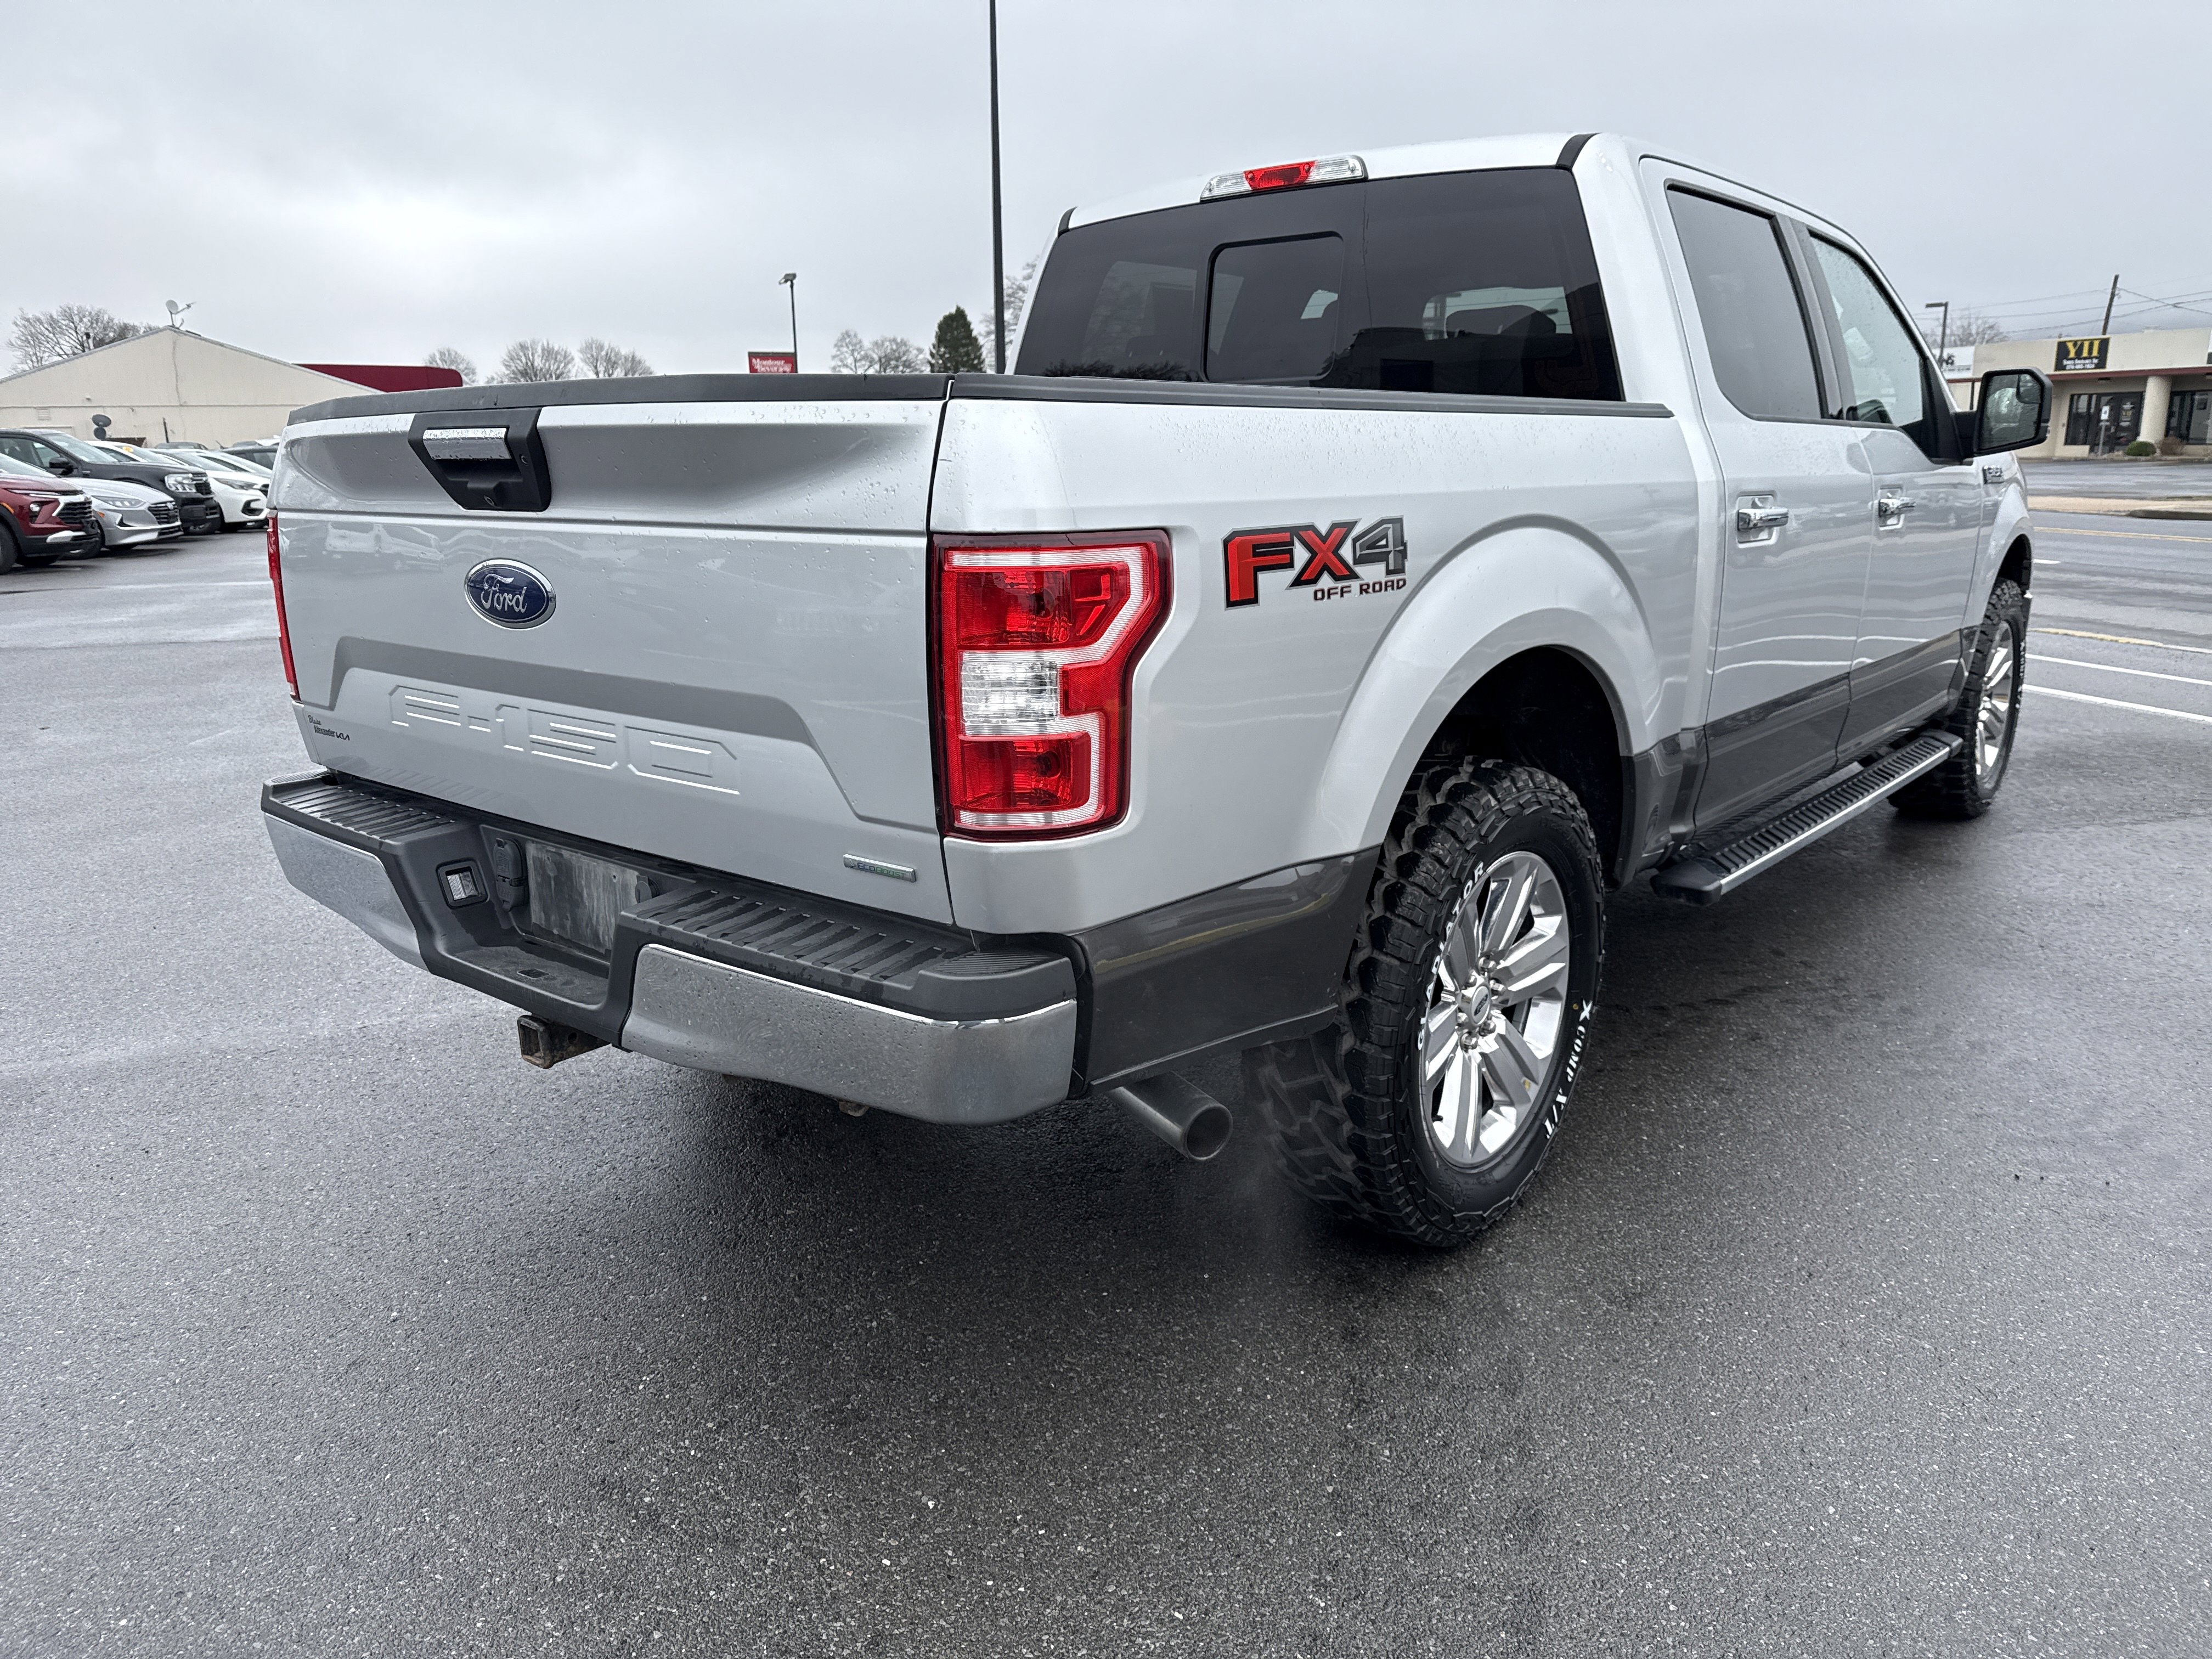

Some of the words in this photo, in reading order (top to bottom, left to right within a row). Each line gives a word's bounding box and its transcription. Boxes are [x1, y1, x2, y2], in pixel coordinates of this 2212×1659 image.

[1221, 515, 1408, 611] FX4
[481, 573, 528, 613] Ford
[1313, 584, 1352, 602] OFF
[1359, 577, 1407, 597] ROAD
[388, 684, 740, 795] F-150
[1578, 998, 1593, 1022] X
[1566, 1025, 1586, 1082] COMP
